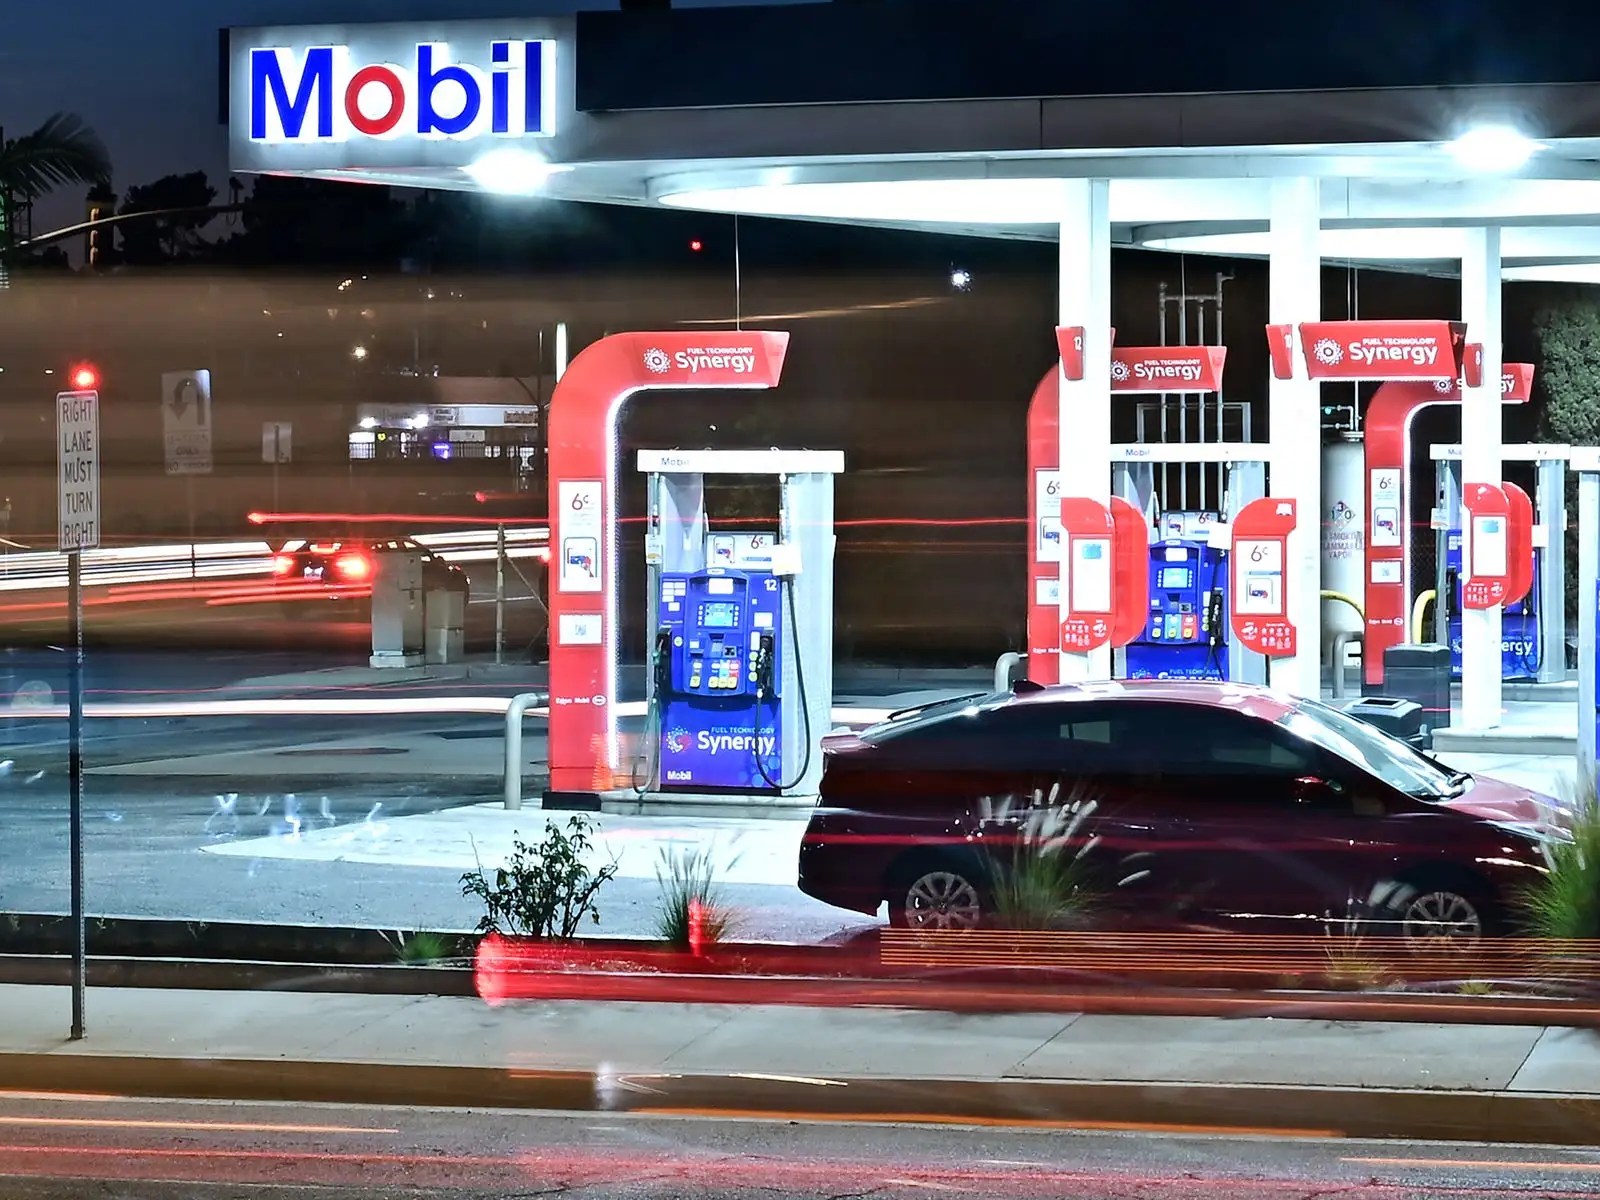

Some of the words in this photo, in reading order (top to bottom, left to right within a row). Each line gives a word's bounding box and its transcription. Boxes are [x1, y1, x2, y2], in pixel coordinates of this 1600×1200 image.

[250, 41, 543, 138] Mobil
[675, 351, 755, 373] Synergy
[1349, 342, 1438, 365] Synergy
[1133, 363, 1202, 380] Synergy
[62, 400, 92, 423] RIGHT
[64, 431, 92, 453] LANE
[64, 460, 92, 483] MUST
[65, 491, 93, 514] TURN
[64, 521, 94, 545] RIGHT
[763, 579, 777, 591] 12
[711, 726, 727, 734] FUEL
[697, 730, 776, 756] Synergy
[667, 770, 692, 781] Mobil
